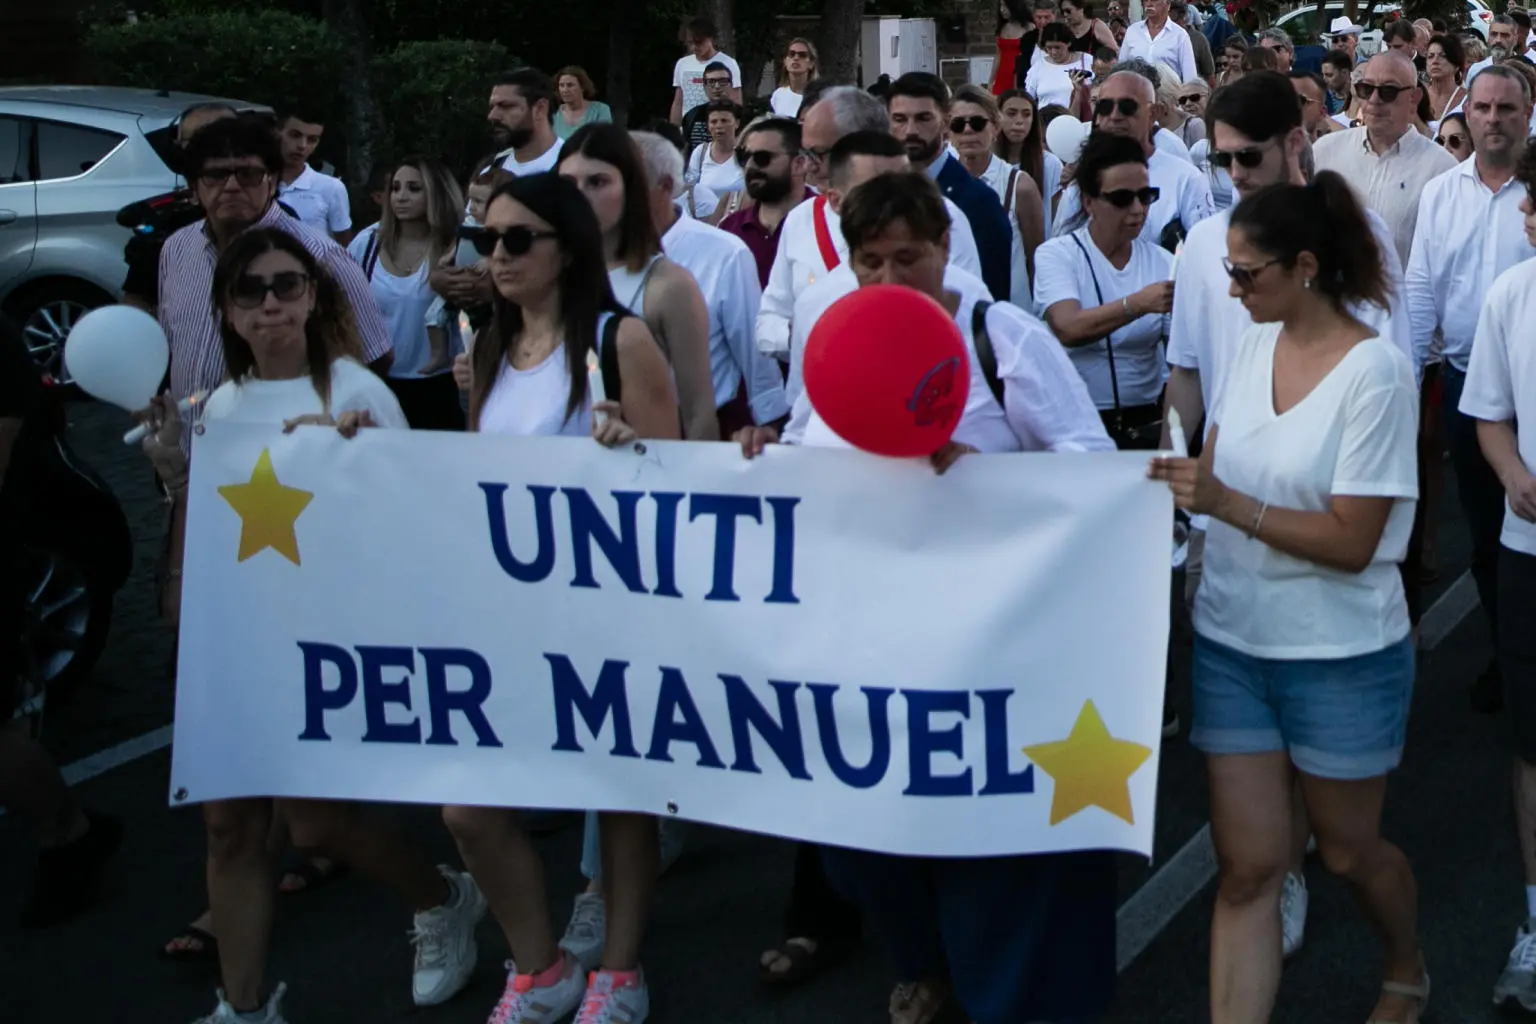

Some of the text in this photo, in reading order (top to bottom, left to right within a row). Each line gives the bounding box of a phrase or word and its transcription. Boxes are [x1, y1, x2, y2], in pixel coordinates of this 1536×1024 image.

[477, 481, 802, 604] UNITI
[296, 640, 1035, 798] PER MANUEL
